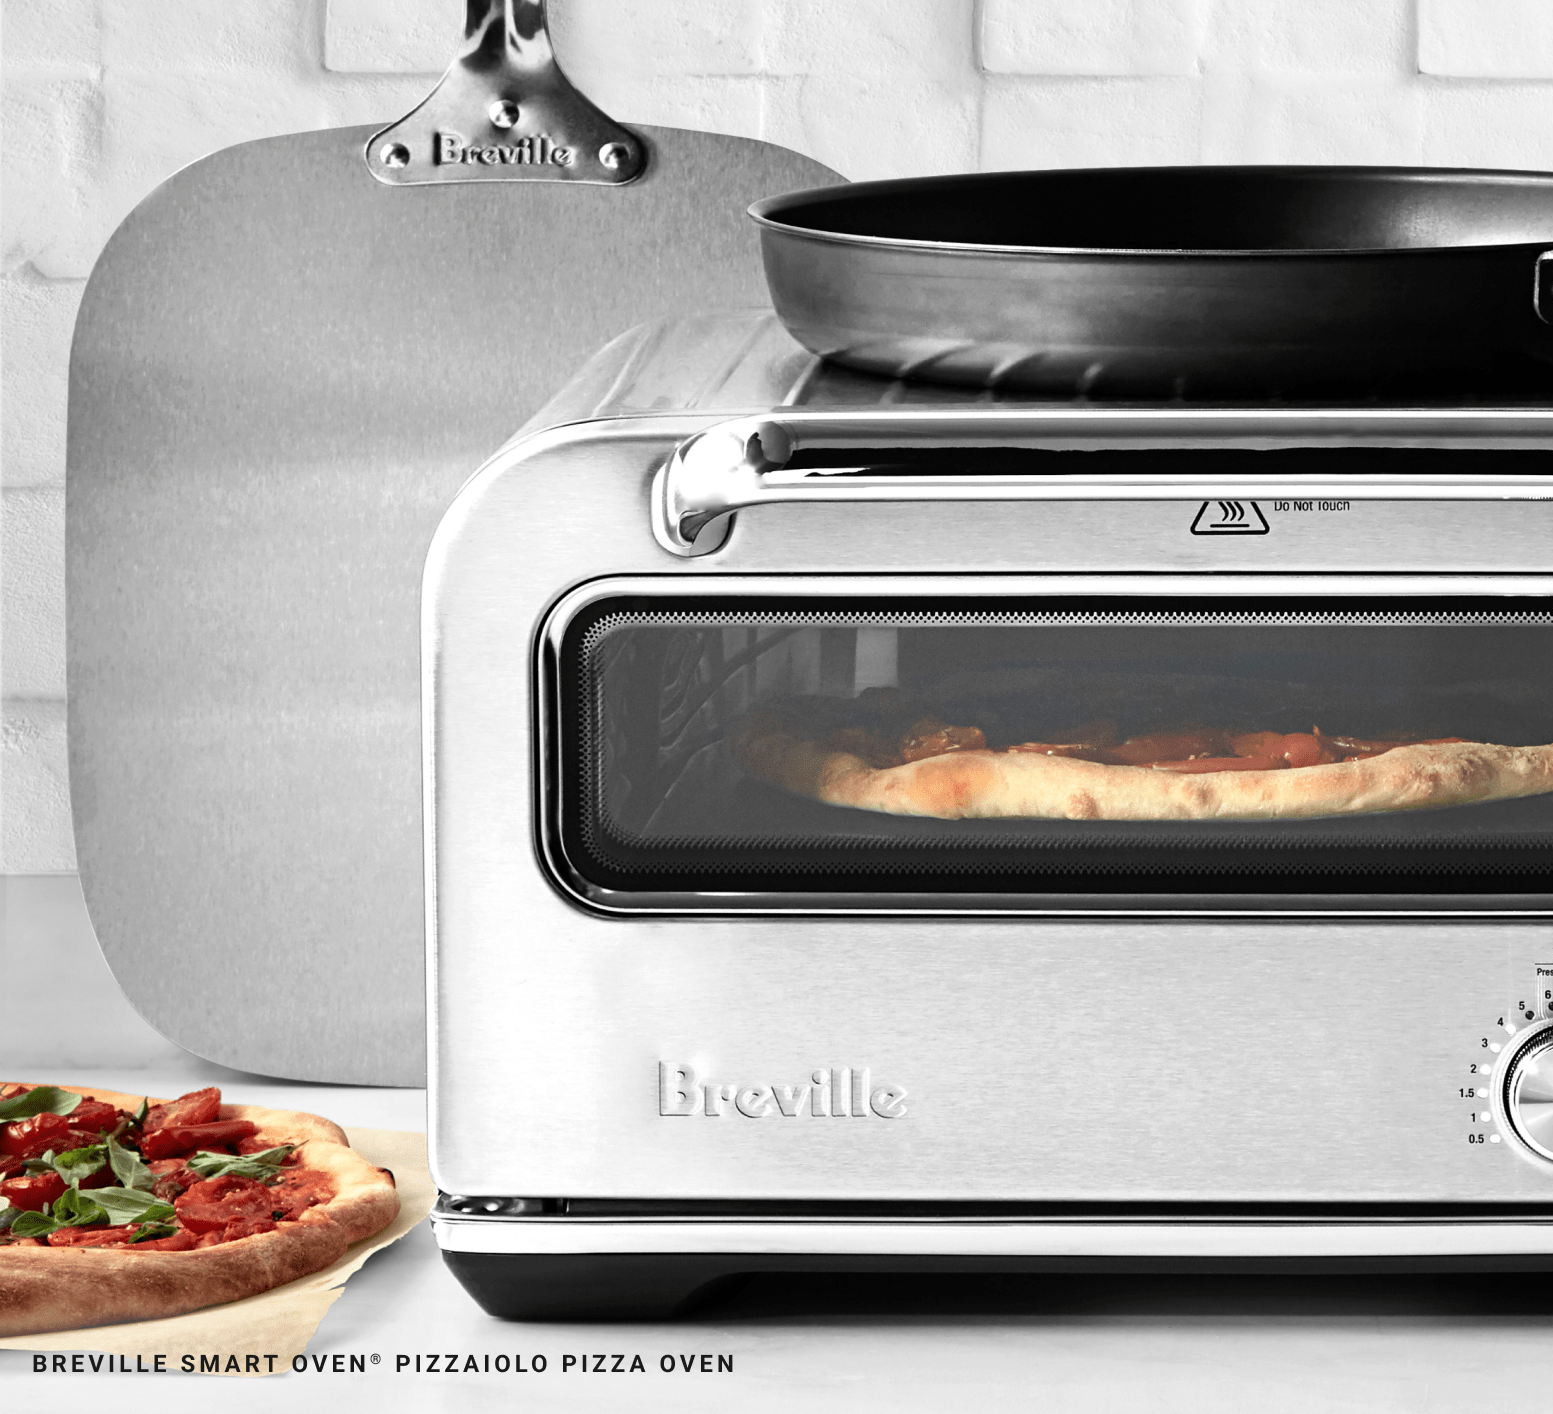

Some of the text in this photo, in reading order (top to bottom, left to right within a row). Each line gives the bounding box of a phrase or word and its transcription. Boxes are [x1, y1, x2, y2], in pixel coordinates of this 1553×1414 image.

[433, 132, 573, 166] Breville
[1274, 501, 1290, 512] Do
[1293, 501, 1314, 512] Not
[1544, 989, 1552, 1000] 6
[1518, 1000, 1526, 1011] 5
[1497, 1016, 1504, 1027] 4
[1481, 1037, 1489, 1048] 3
[1470, 1063, 1478, 1074] 2
[658, 1060, 909, 1119] Breville
[1458, 1088, 1475, 1099] 1.5
[1468, 1133, 1485, 1144] 0.5
